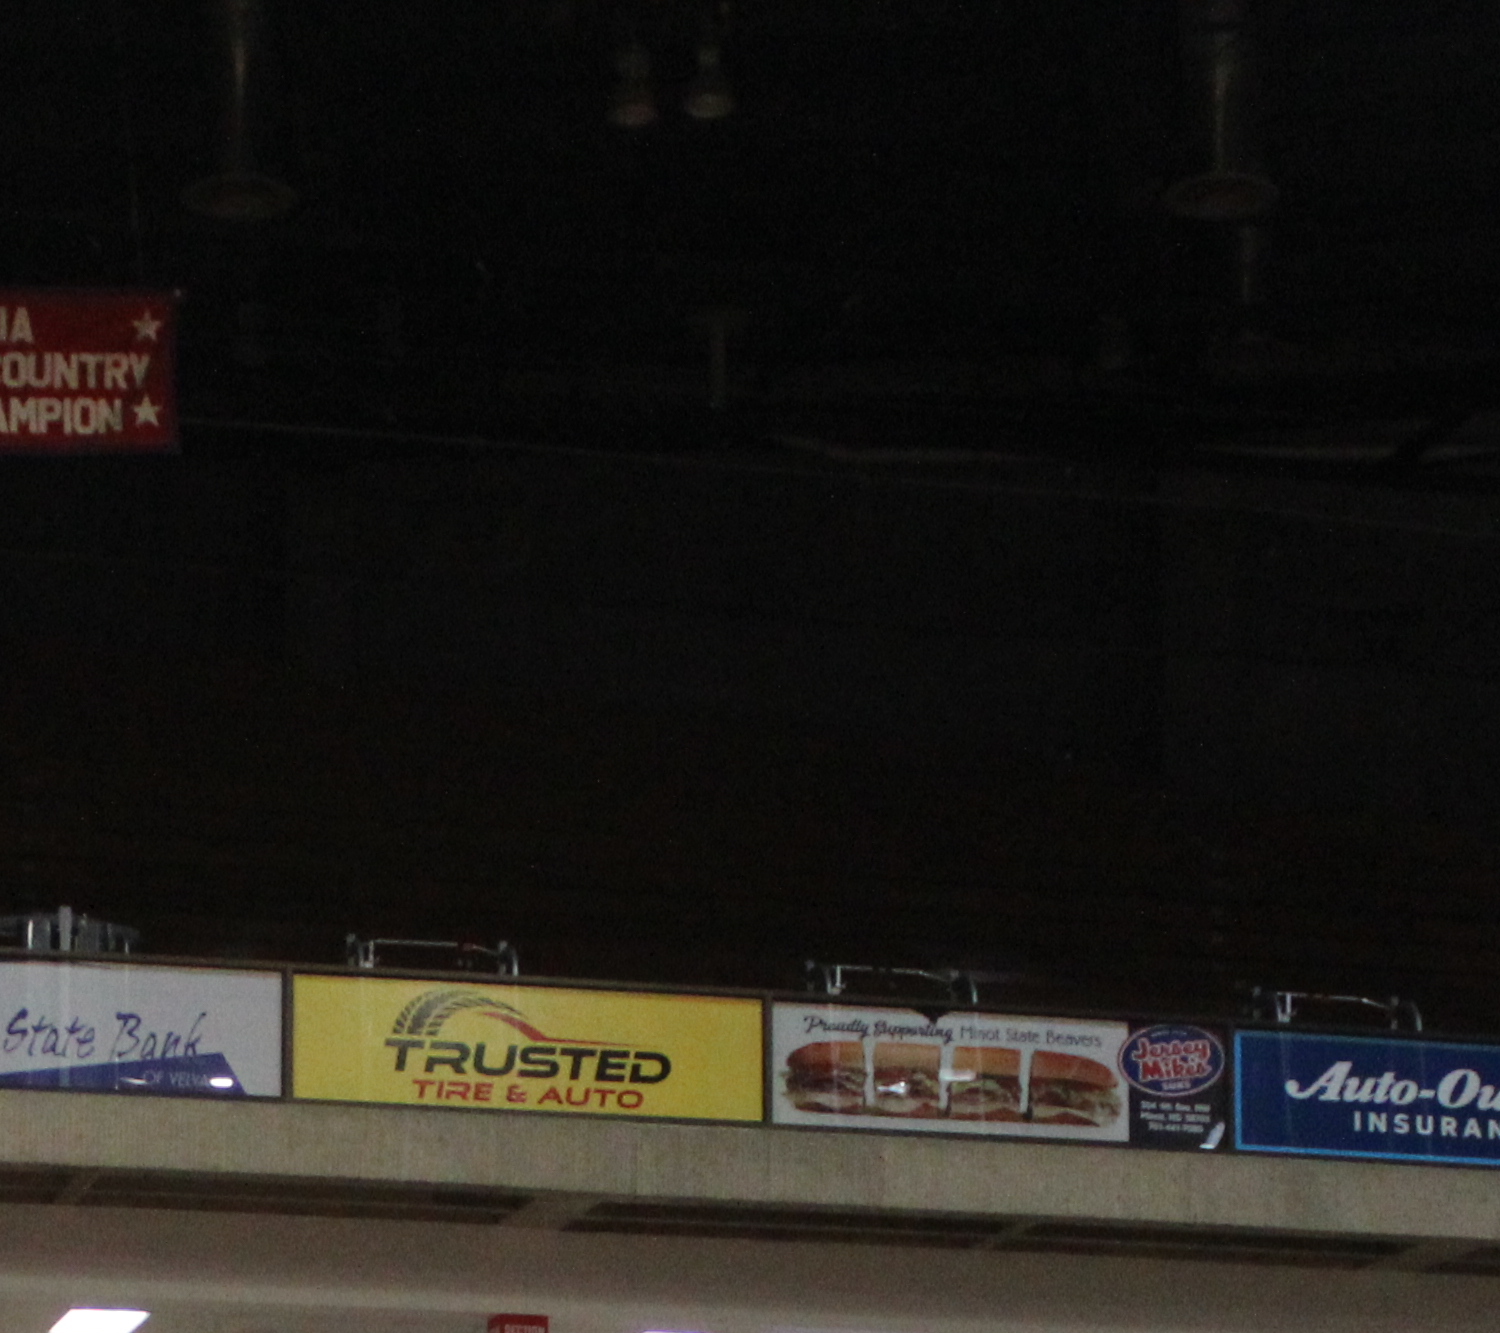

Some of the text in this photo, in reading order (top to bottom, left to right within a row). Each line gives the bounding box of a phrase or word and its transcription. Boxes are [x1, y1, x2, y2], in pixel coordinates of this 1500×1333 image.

[3, 1008, 95, 1058] State
[109, 1012, 207, 1061] Bank
[803, 1015, 1102, 1049] Proudly Supporting Minot State Beavers
[1132, 1037, 1210, 1060] Jersey
[384, 1038, 672, 1085] TRUSTED
[411, 1080, 645, 1110] TIRE & AUTO
